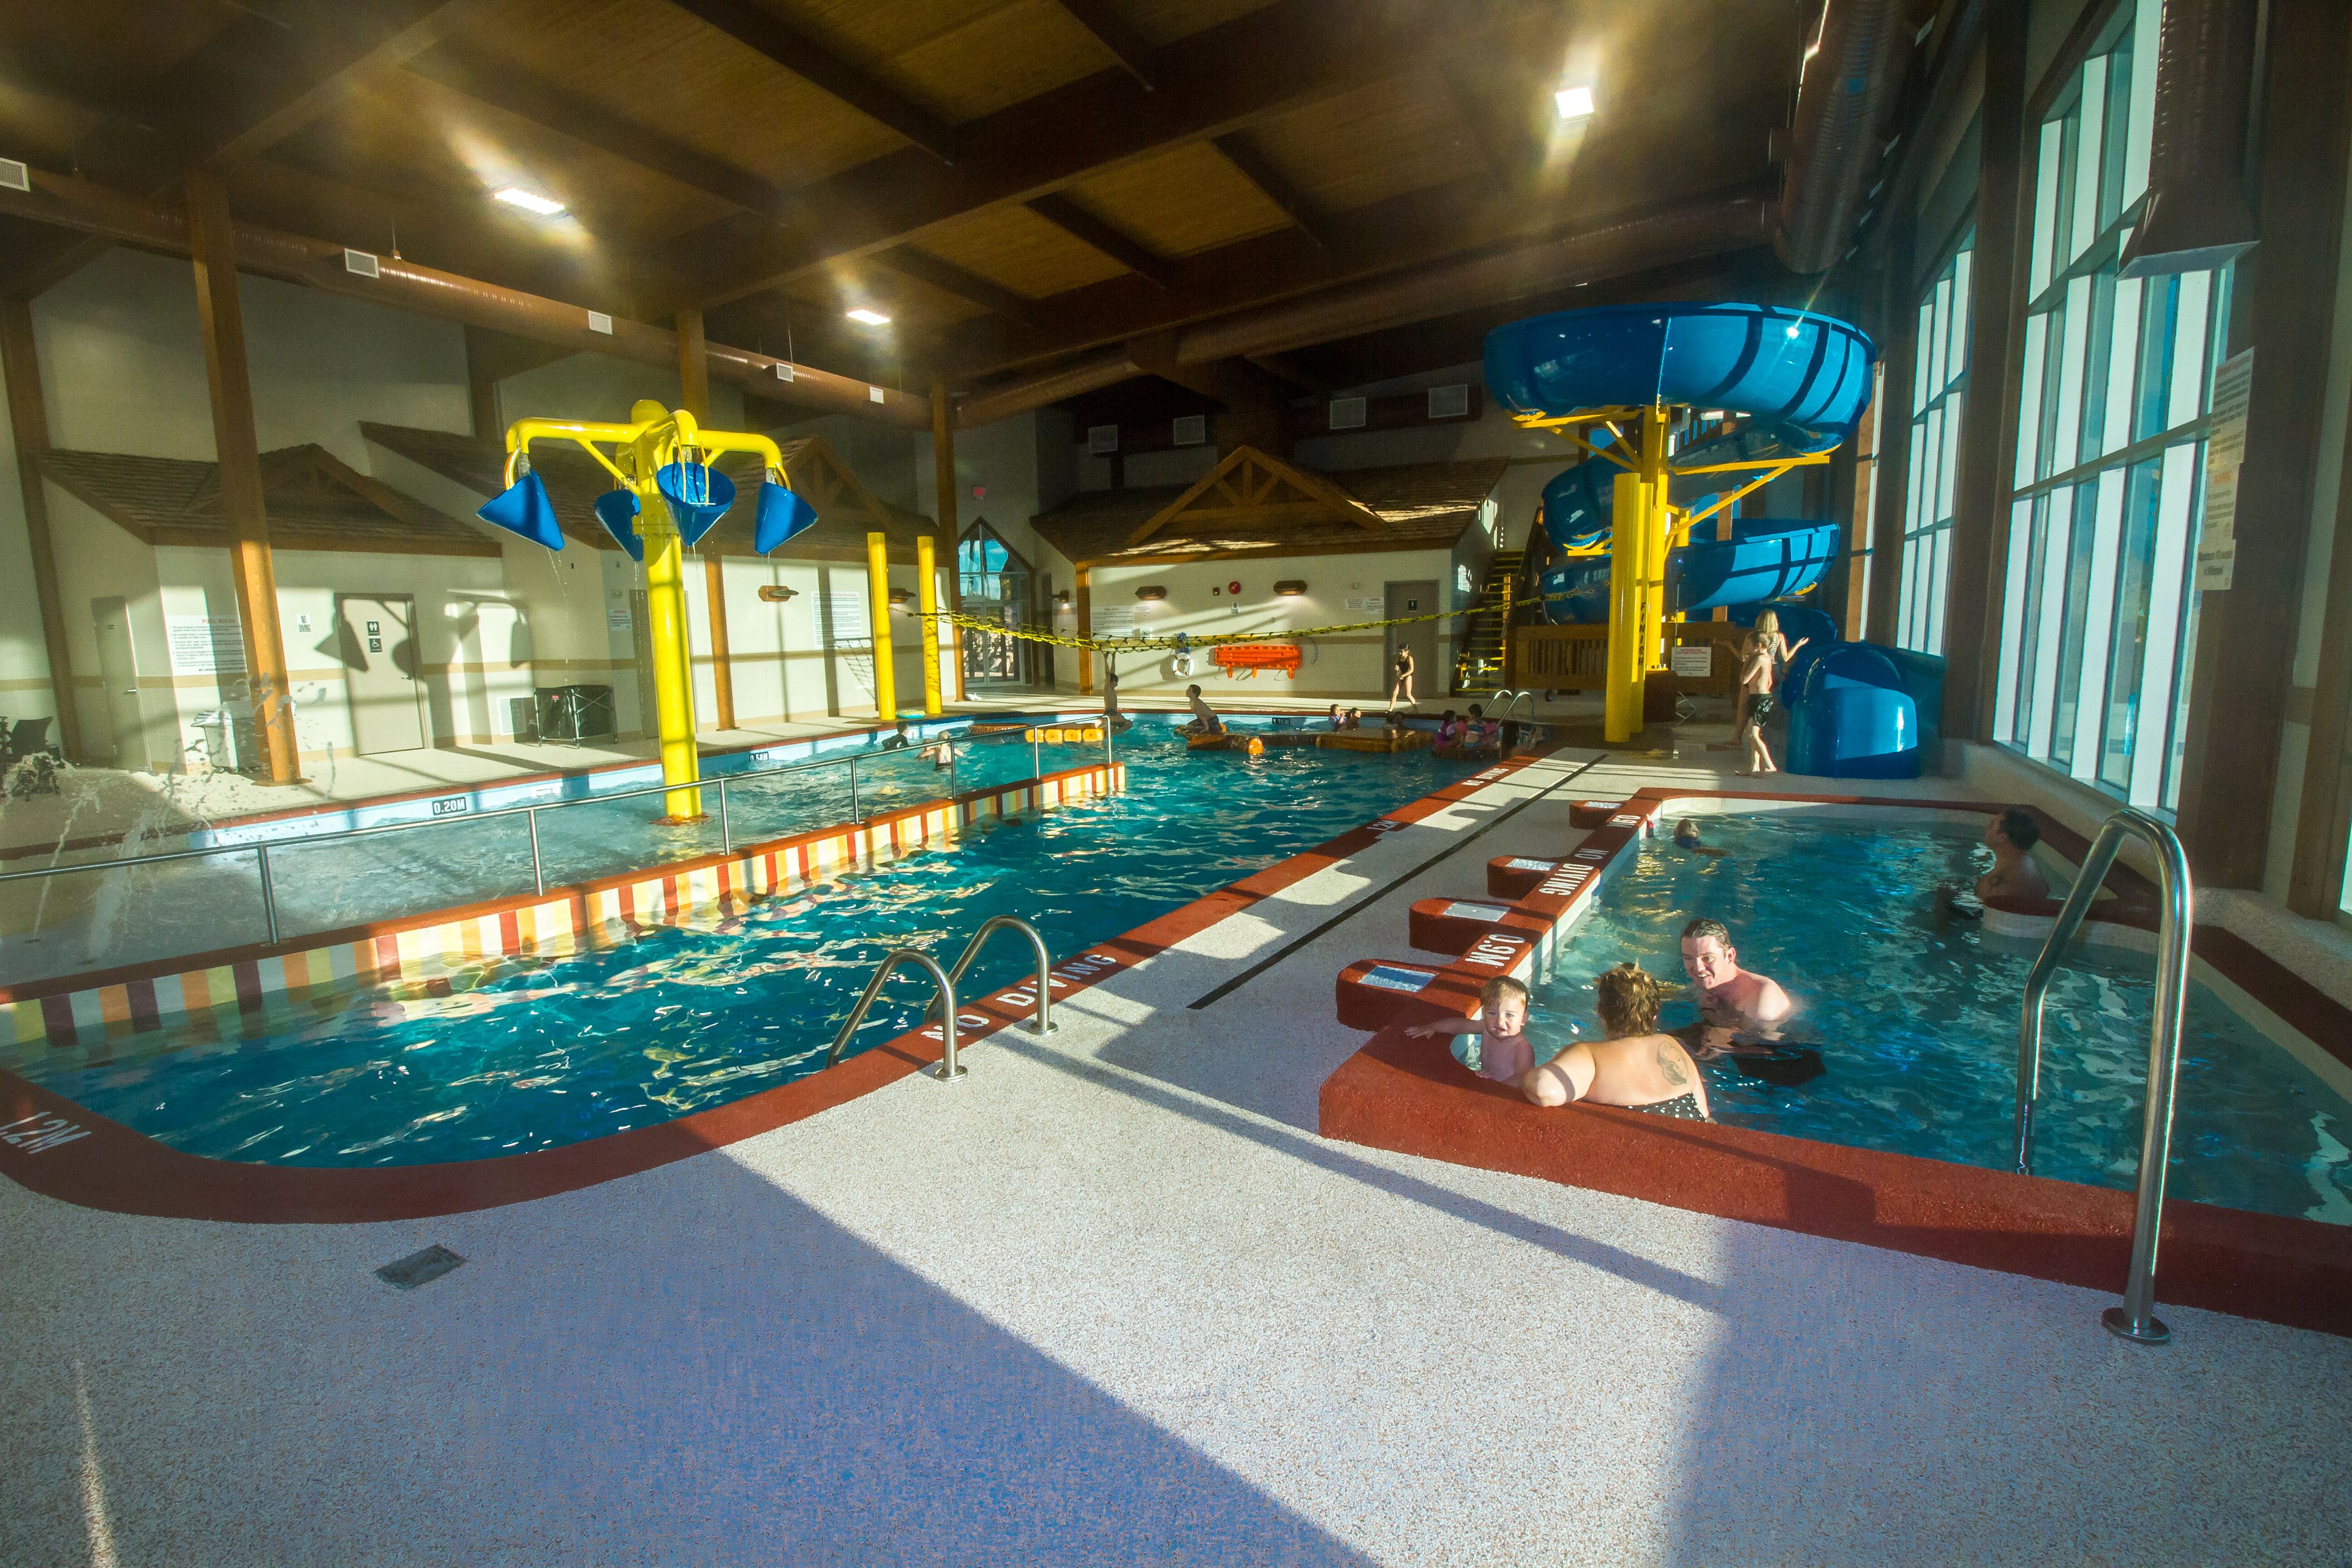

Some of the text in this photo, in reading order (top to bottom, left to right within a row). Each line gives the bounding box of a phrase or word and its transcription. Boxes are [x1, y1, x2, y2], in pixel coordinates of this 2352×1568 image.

[1638, 602, 1646, 666] FINISH
[750, 752, 768, 761] 058M
[433, 798, 466, 814] 0.20M
[1538, 848, 1610, 896] NO DIVING
[1464, 933, 1525, 967] 0.9M
[921, 954, 1117, 1041] NO DIVING
